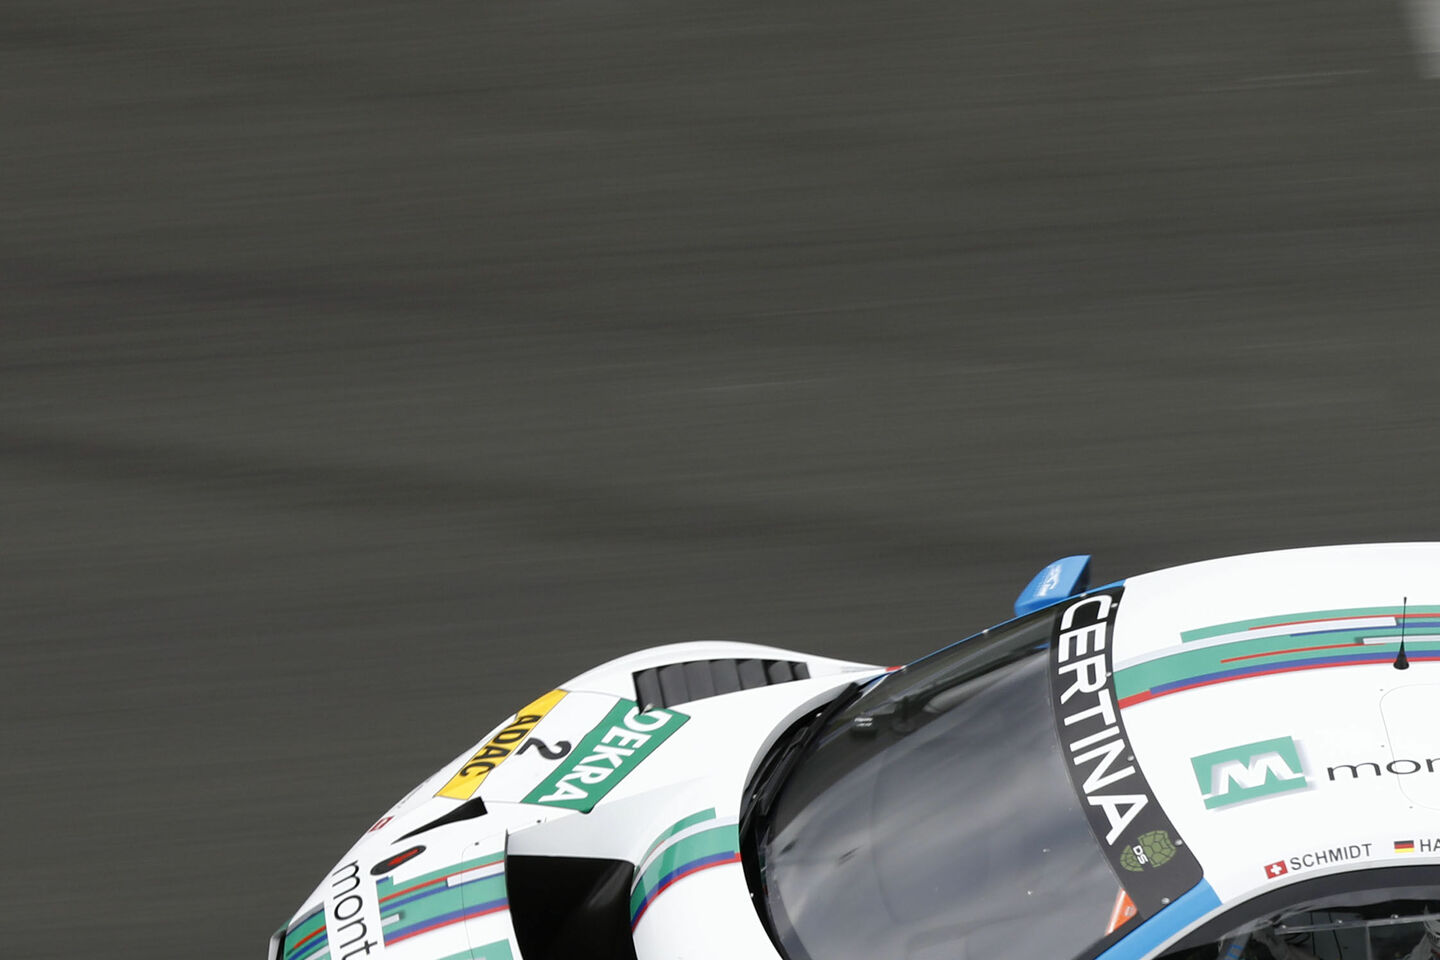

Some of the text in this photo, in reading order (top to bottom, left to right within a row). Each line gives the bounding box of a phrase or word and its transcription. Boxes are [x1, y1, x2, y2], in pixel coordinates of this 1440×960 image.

[1057, 595, 1149, 845] CERTINA
[460, 714, 544, 778] ADAC
[515, 737, 572, 761] 2
[537, 705, 673, 804] DEKRA
[1132, 845, 1149, 865] DS
[1290, 842, 1373, 871] SCHMIDT
